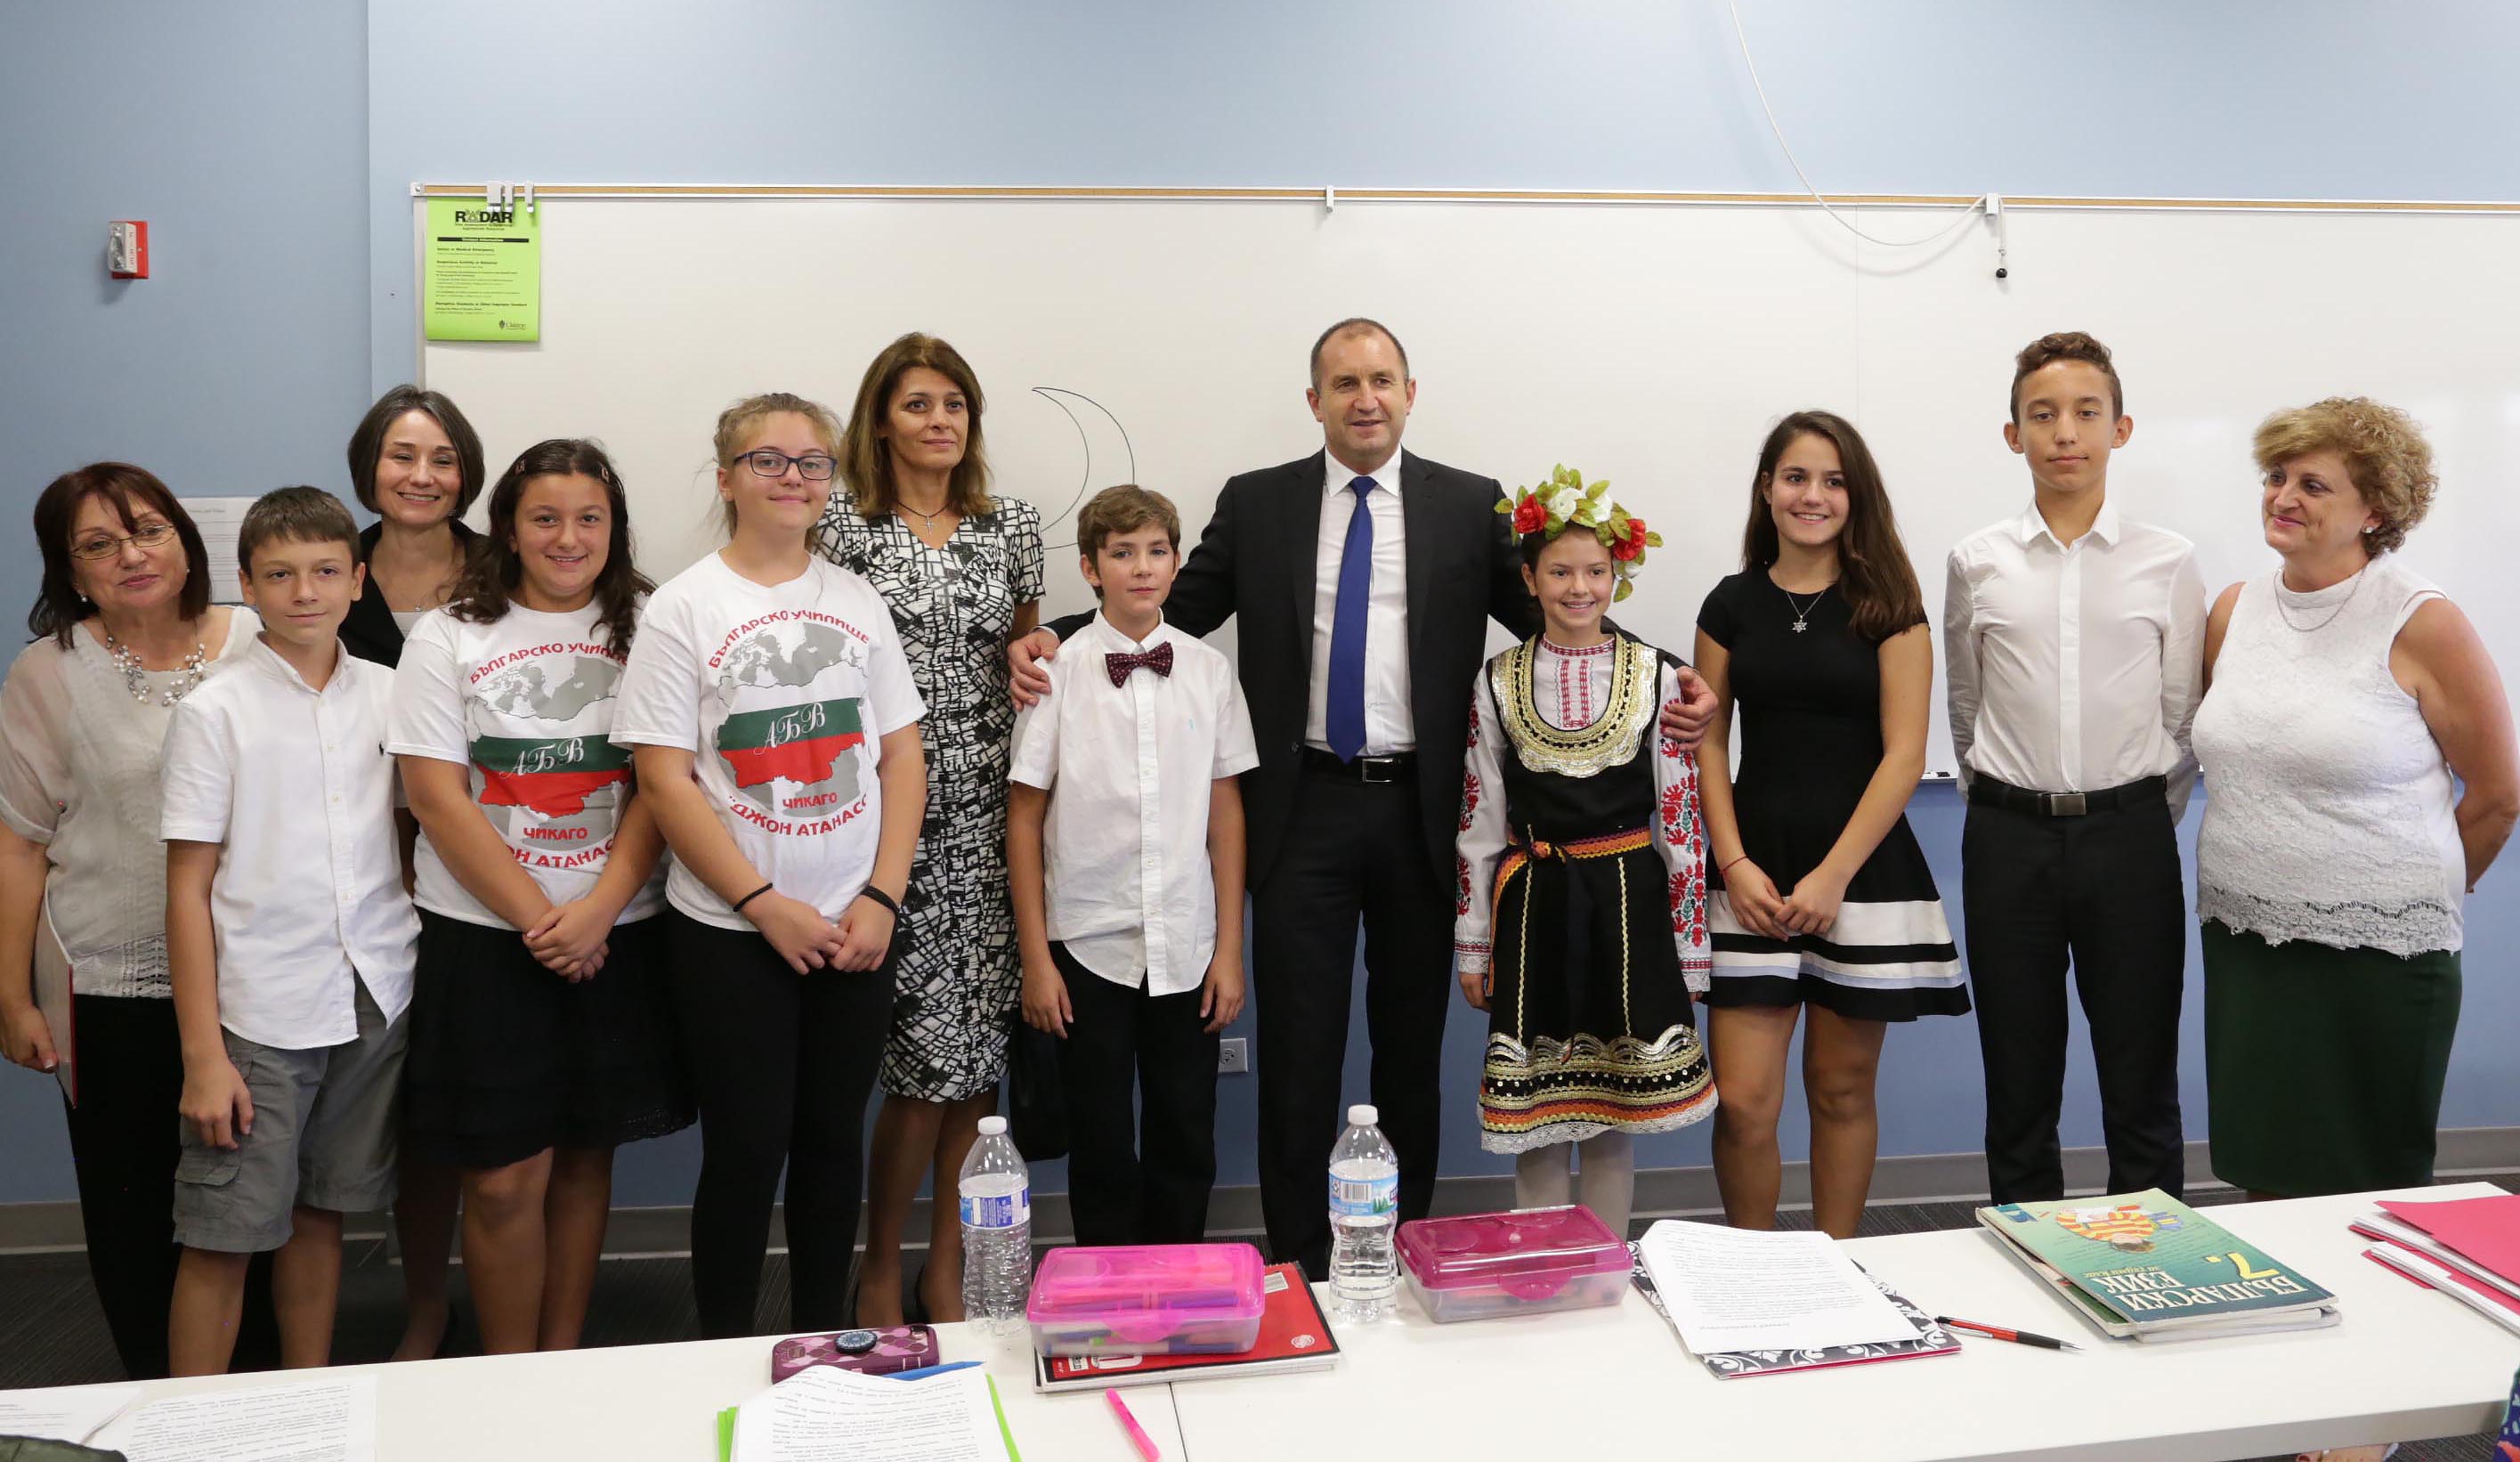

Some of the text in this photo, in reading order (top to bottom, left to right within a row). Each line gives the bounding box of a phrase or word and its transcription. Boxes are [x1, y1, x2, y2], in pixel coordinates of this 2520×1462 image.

[709, 610, 870, 669] БЪЛГАРСКО УЧИЛИЩЕ
[470, 643, 563, 684] БЪЛГАРСКО
[754, 703, 826, 755] АБВ
[499, 738, 585, 778] АБВ
[782, 792, 838, 809] ЧИКАГО
[523, 826, 588, 841] ЧИКАГО
[2090, 1271, 2186, 1294] ЕЗИК
[2115, 1276, 2307, 1311] БЪЛГАРСКИ
